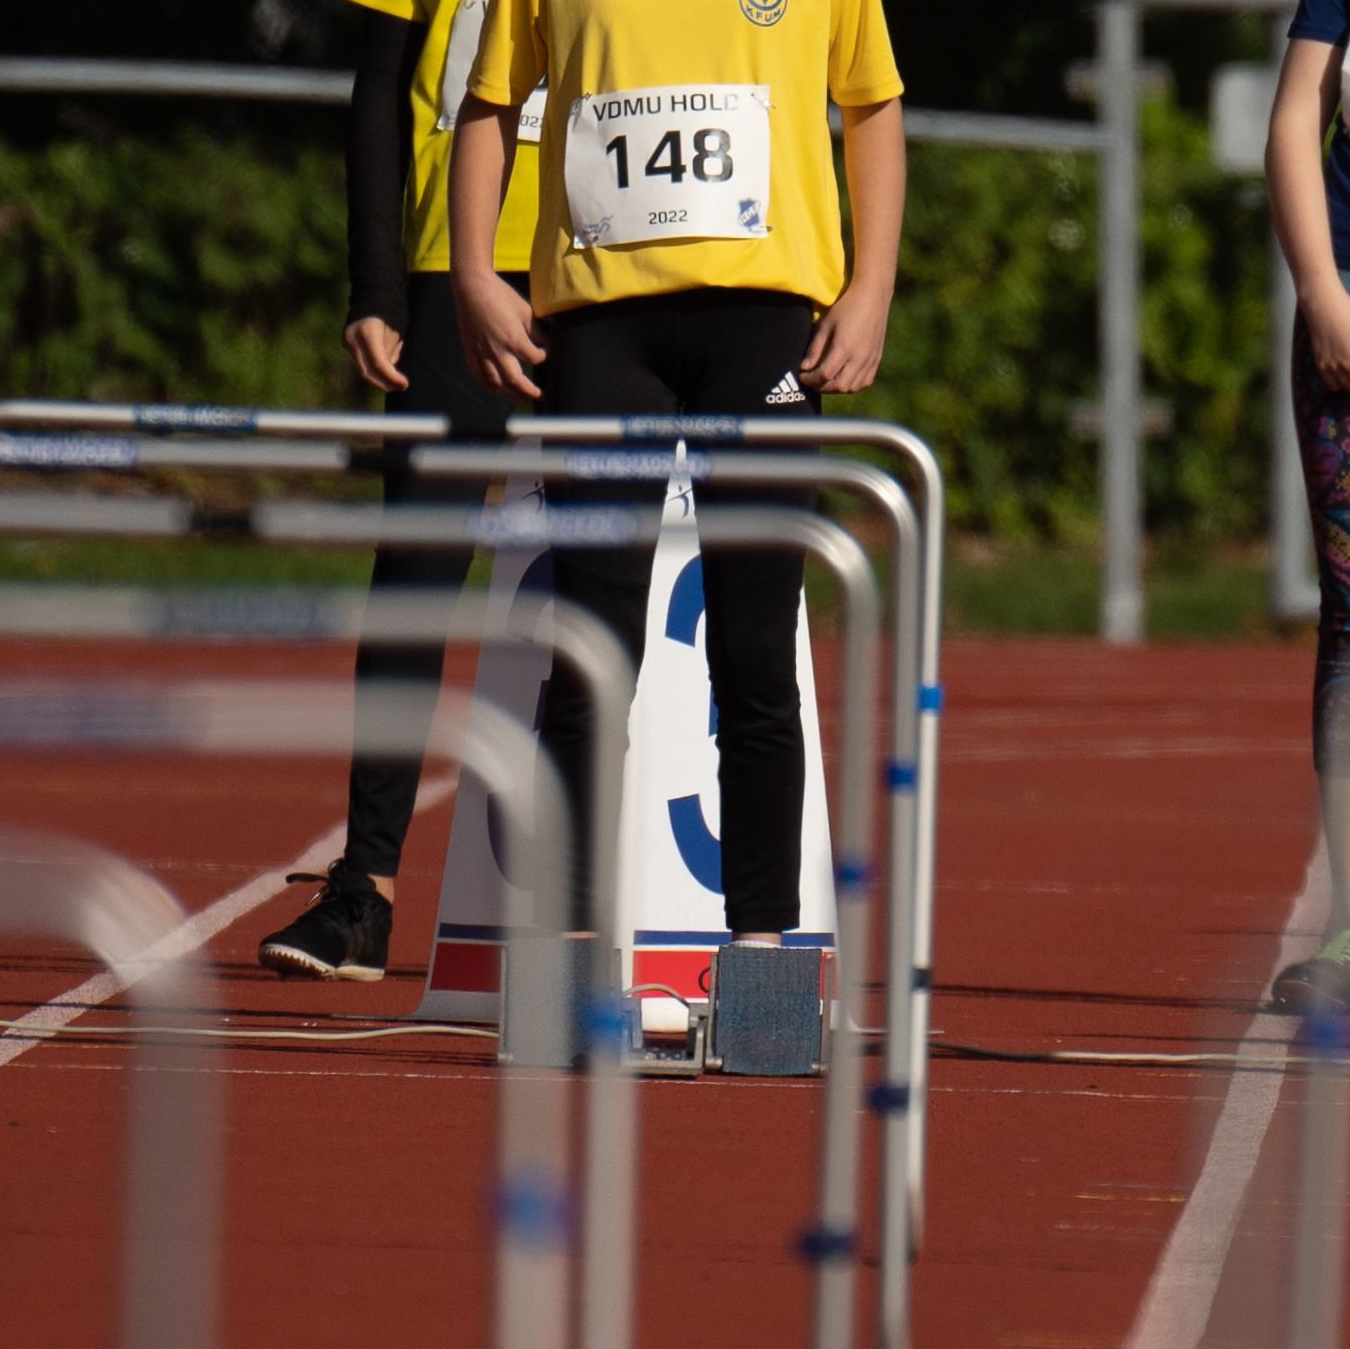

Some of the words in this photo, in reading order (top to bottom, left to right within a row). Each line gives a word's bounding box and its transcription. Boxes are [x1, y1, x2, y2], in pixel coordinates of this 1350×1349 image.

[592, 95, 662, 122] VDMU
[605, 128, 734, 190] 148
[648, 209, 688, 225] 2022
[765, 391, 806, 404] adidas
